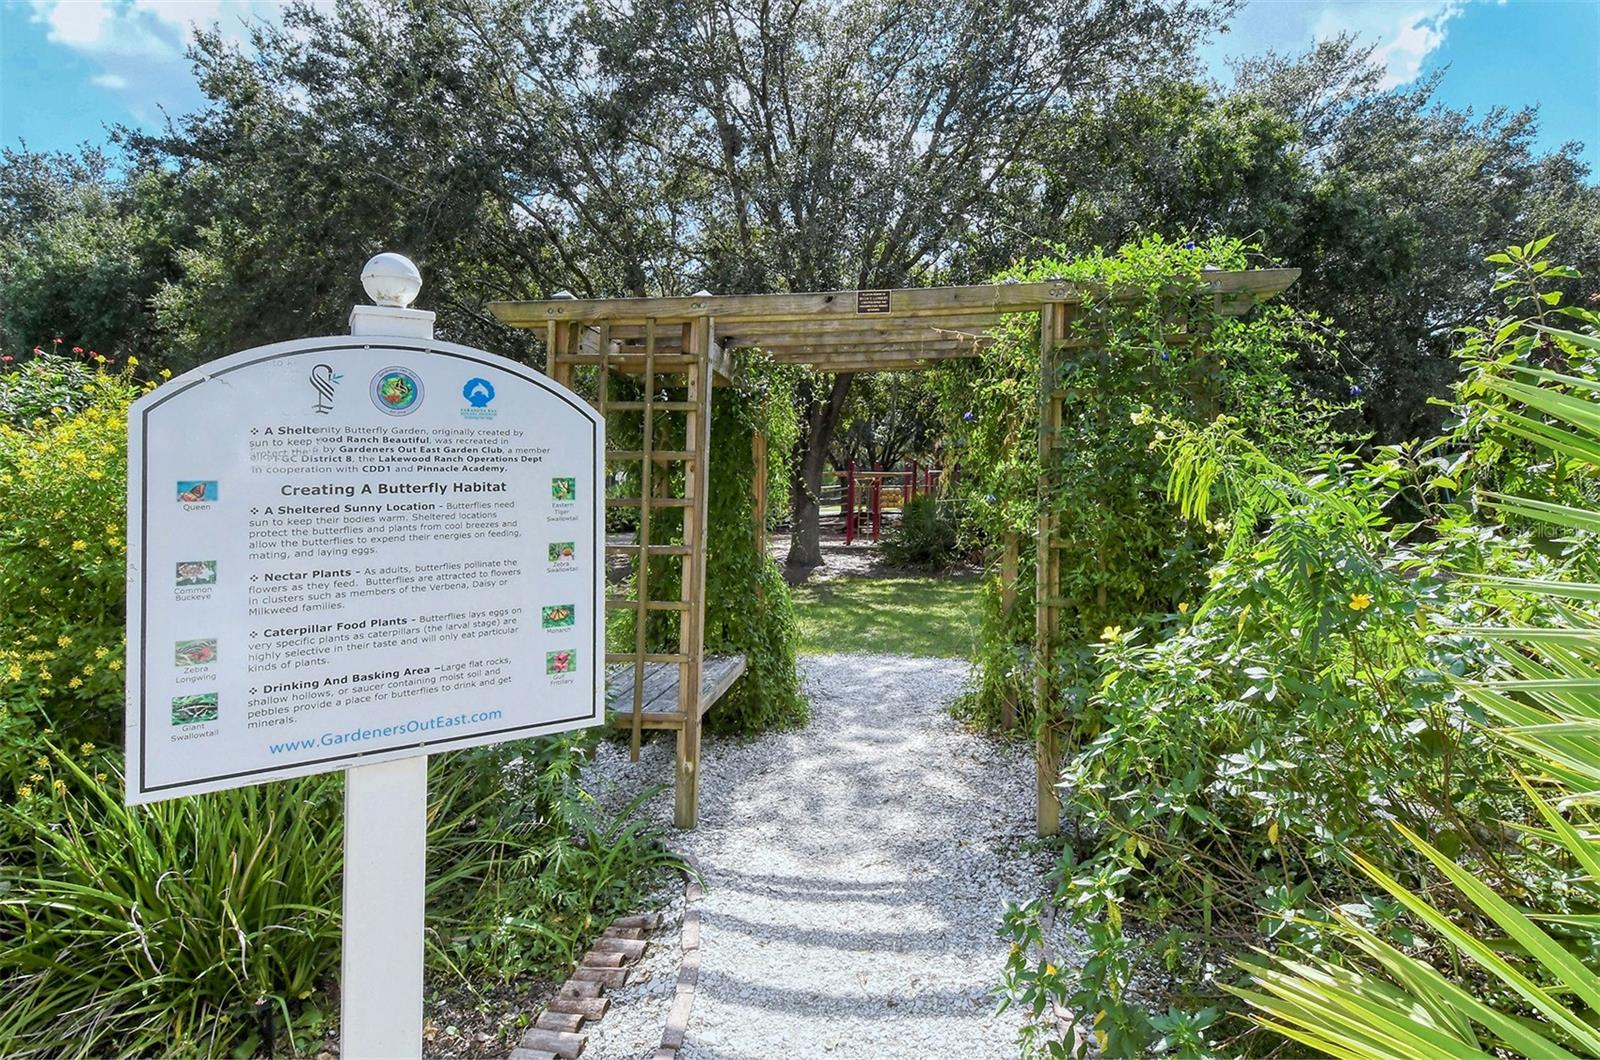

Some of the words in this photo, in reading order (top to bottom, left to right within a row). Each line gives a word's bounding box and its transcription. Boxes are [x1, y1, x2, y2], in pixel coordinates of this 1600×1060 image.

[264, 427, 273, 435] A
[345, 426, 388, 436] Butterfly
[391, 427, 428, 435] Garden,
[432, 428, 475, 436] originally
[478, 428, 510, 436] created
[288, 438, 312, 447] keep
[382, 436, 432, 444] Beautiful,
[339, 445, 394, 453] Gardeners
[398, 446, 416, 454] Out
[420, 446, 440, 454] East
[443, 446, 478, 454] Garden
[481, 446, 504, 454] Club,
[302, 455, 341, 463] District
[466, 456, 518, 464] Operations
[521, 456, 542, 464] Dept
[266, 466, 332, 474] cooperation
[362, 465, 391, 473] CDD1
[462, 465, 508, 473] Academy.
[281, 484, 355, 497] Creating
[361, 484, 372, 494] A
[378, 483, 448, 495] Butterfly
[453, 482, 507, 492] Habitat
[278, 505, 340, 514] Sheltered
[344, 505, 382, 514] Sunny
[386, 503, 435, 512] Location
[446, 501, 492, 510] Butterflies
[494, 500, 515, 509] need
[287, 517, 312, 527] keep
[316, 516, 340, 525] their
[343, 515, 375, 524] bodies
[412, 512, 456, 521] Sheltered
[458, 511, 497, 520] locations
[249, 529, 288, 539] protect
[292, 527, 308, 536] the
[312, 525, 366, 535] butterflies
[367, 524, 385, 533] and
[388, 523, 417, 533] plants
[420, 522, 442, 531] from
[444, 521, 462, 530] cool
[466, 521, 499, 529] breezes
[502, 519, 518, 528] and
[248, 540, 277, 549] allow
[281, 539, 298, 547] the
[302, 537, 354, 546] butterflies
[370, 534, 406, 544] expend
[409, 533, 431, 542] their
[433, 531, 472, 541] energies
[488, 529, 522, 539] feeding,
[249, 550, 290, 559] mating,
[293, 548, 314, 557] and
[316, 547, 348, 558] laying
[351, 548, 378, 556] eggs.
[264, 572, 308, 581] Nectar
[312, 569, 352, 578] Plants
[363, 567, 376, 575] As
[379, 565, 412, 574] adults,
[415, 562, 461, 572] butterflies
[464, 560, 501, 571] pollinate
[504, 558, 518, 567] the
[248, 585, 288, 594] flowers
[307, 581, 330, 590] they
[333, 579, 358, 588] feed.
[366, 575, 415, 586] Butterflies
[436, 570, 476, 581] attracted
[491, 569, 521, 577] flowers
[174, 587, 212, 595] Common
[262, 594, 304, 603] clusters
[308, 590, 332, 600] such
[350, 587, 396, 596] members
[411, 584, 426, 592] the
[430, 581, 470, 591] Verbena,
[472, 579, 496, 588] Daisy
[249, 604, 298, 615] Milkweed
[302, 602, 345, 612] families.
[264, 624, 333, 637] Caterpillar
[337, 620, 366, 630] Food
[370, 617, 409, 627] Plants
[419, 612, 466, 623] Butterflies
[468, 610, 486, 619] lays
[488, 609, 509, 618] eggs
[248, 642, 272, 650] very
[276, 636, 316, 648] specific
[319, 634, 350, 645] plants
[368, 627, 420, 638] caterpillars
[424, 624, 443, 635] (the
[446, 621, 470, 631] larval
[473, 618, 500, 628] stage)
[248, 650, 281, 661] highly
[284, 646, 330, 657] selective
[346, 641, 370, 651] their
[373, 639, 398, 648] taste
[400, 636, 418, 645] and
[421, 634, 436, 643] will
[439, 632, 460, 642] only
[461, 631, 476, 639] eat
[478, 626, 519, 639] particular
[183, 666, 208, 674] Zebra
[248, 662, 277, 672] kinds
[295, 658, 330, 669] plants.
[176, 673, 216, 684] Longwing
[263, 681, 319, 693] Drinking
[324, 675, 348, 686] And
[352, 671, 400, 682] Basking
[403, 667, 430, 676] Area
[434, 663, 466, 672] –Large
[469, 660, 484, 669] flat
[486, 657, 512, 667] rocks,
[248, 696, 288, 707] shallow
[292, 690, 334, 701] hollows,
[352, 684, 385, 694] saucer
[387, 677, 436, 689] containing
[440, 672, 464, 682] moist
[467, 669, 482, 679] soil
[484, 667, 501, 677] and
[247, 705, 290, 719] pebbles
[293, 699, 332, 713] provide
[345, 695, 372, 706] place
[375, 692, 388, 701] for
[391, 686, 439, 698] butterflies
[454, 680, 477, 690] drink
[480, 677, 496, 687] and
[498, 676, 512, 686] get
[182, 724, 206, 732] Giant
[248, 716, 297, 728] minerals.
[171, 730, 219, 742] Swallowtail
[269, 710, 502, 754] www.GardenersOutEast.com
